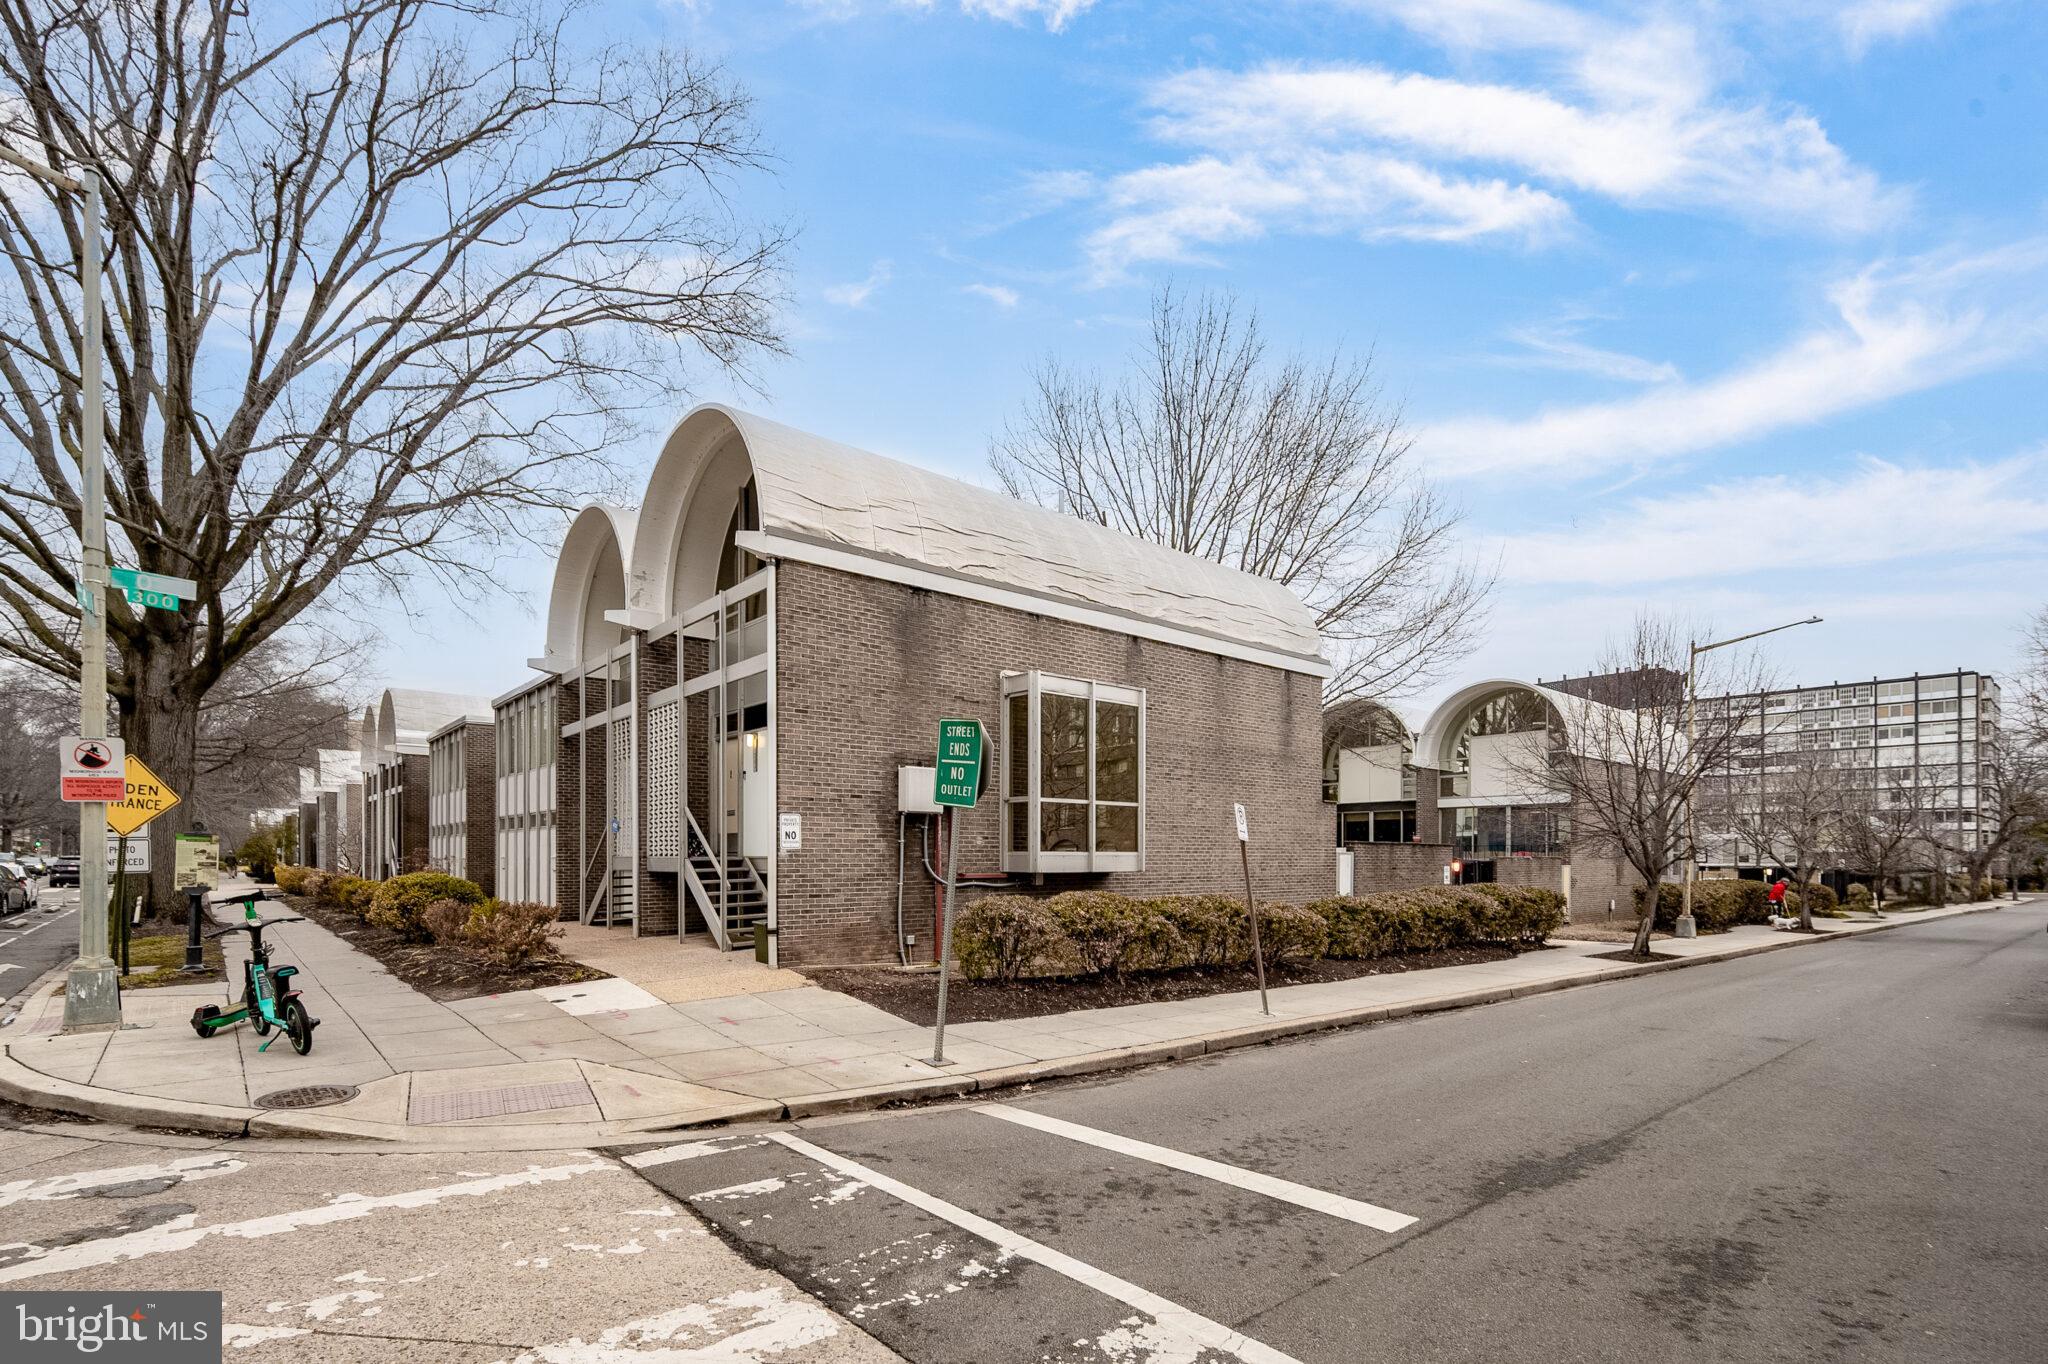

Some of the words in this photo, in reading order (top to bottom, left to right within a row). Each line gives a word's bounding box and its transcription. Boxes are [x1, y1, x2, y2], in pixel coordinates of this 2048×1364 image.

[132, 591, 174, 609] 300
[946, 725, 975, 738] STREET
[949, 742, 970, 756] ENDS
[950, 766, 965, 780] NO
[126, 783, 159, 796] DEN
[940, 784, 972, 797] OUTLET
[110, 798, 162, 810] RANCE
[785, 831, 797, 840] NO
[108, 845, 136, 854] PHTO
[106, 857, 145, 867] NFRCED
